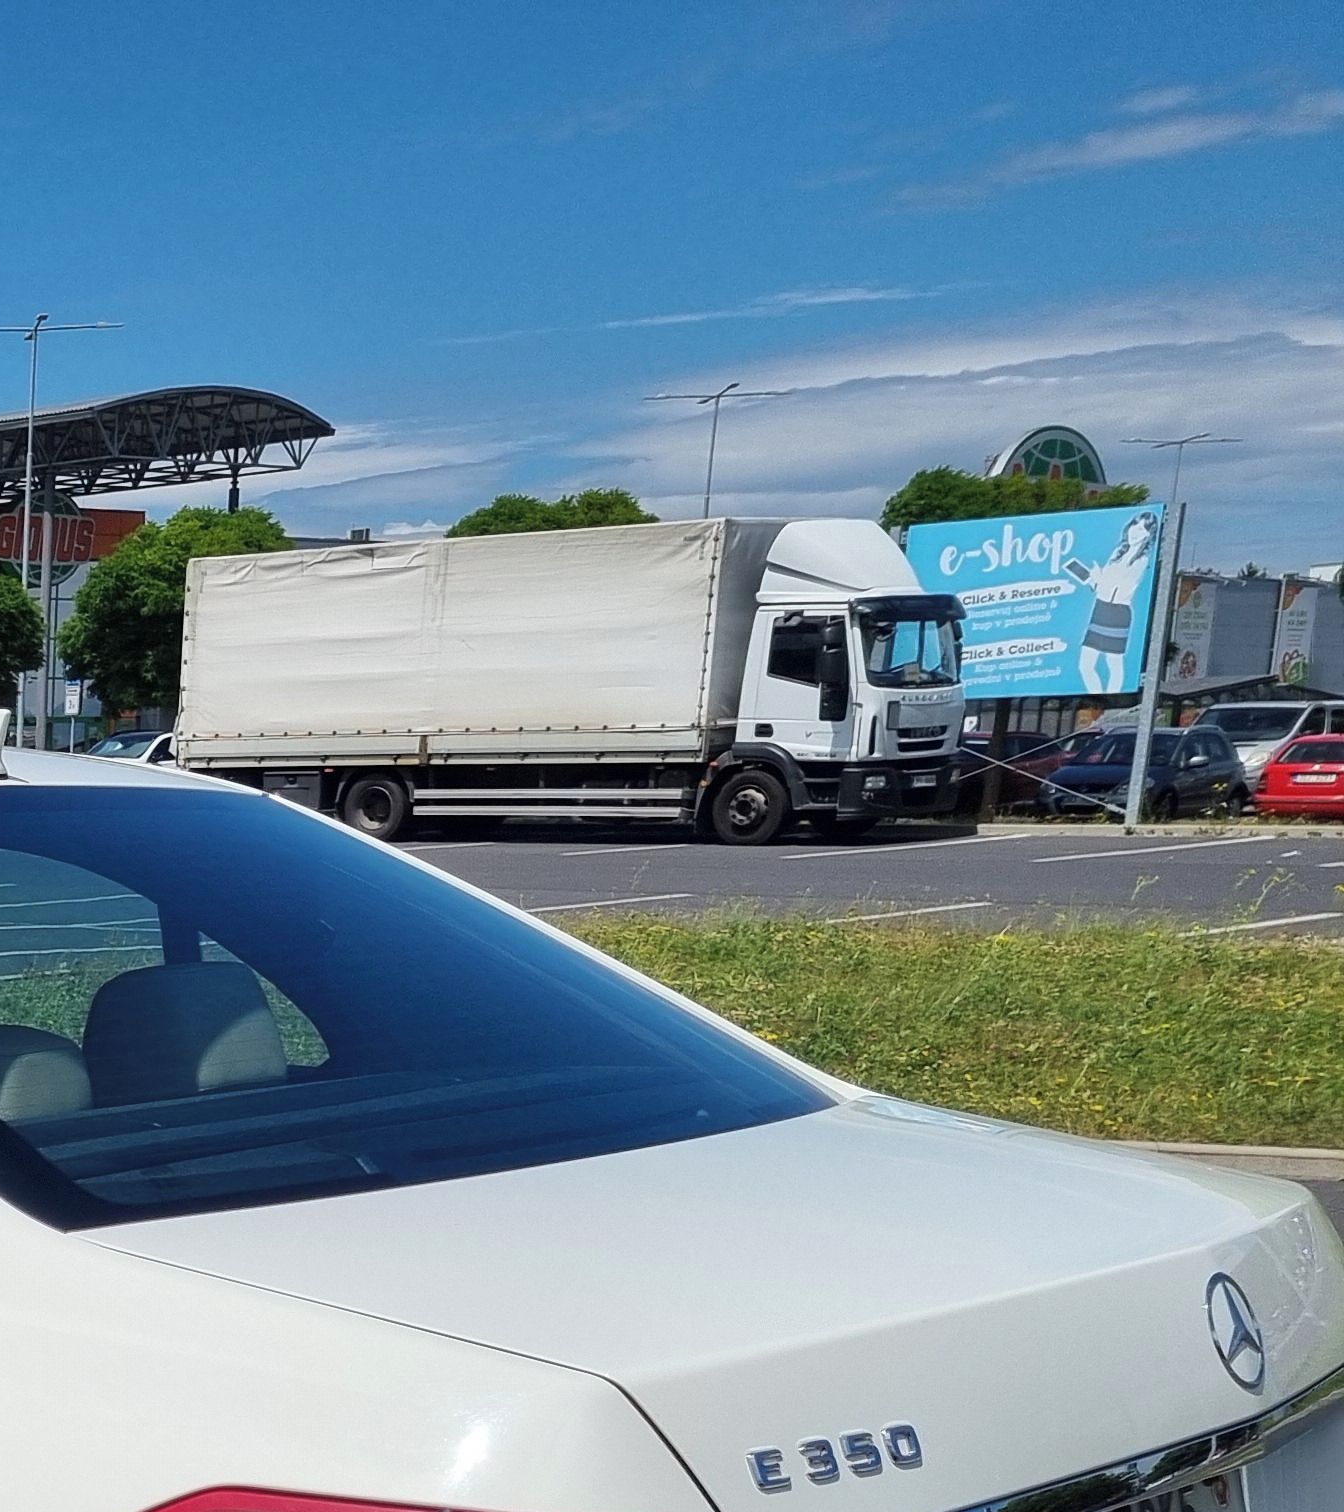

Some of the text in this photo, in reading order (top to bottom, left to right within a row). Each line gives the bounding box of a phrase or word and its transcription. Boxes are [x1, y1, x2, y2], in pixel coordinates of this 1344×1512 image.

[940, 524, 1074, 575] e-shop
[962, 585, 1061, 605] Click & Reserve
[961, 640, 1054, 660] Click & Collect
[745, 1421, 924, 1494] E 350
